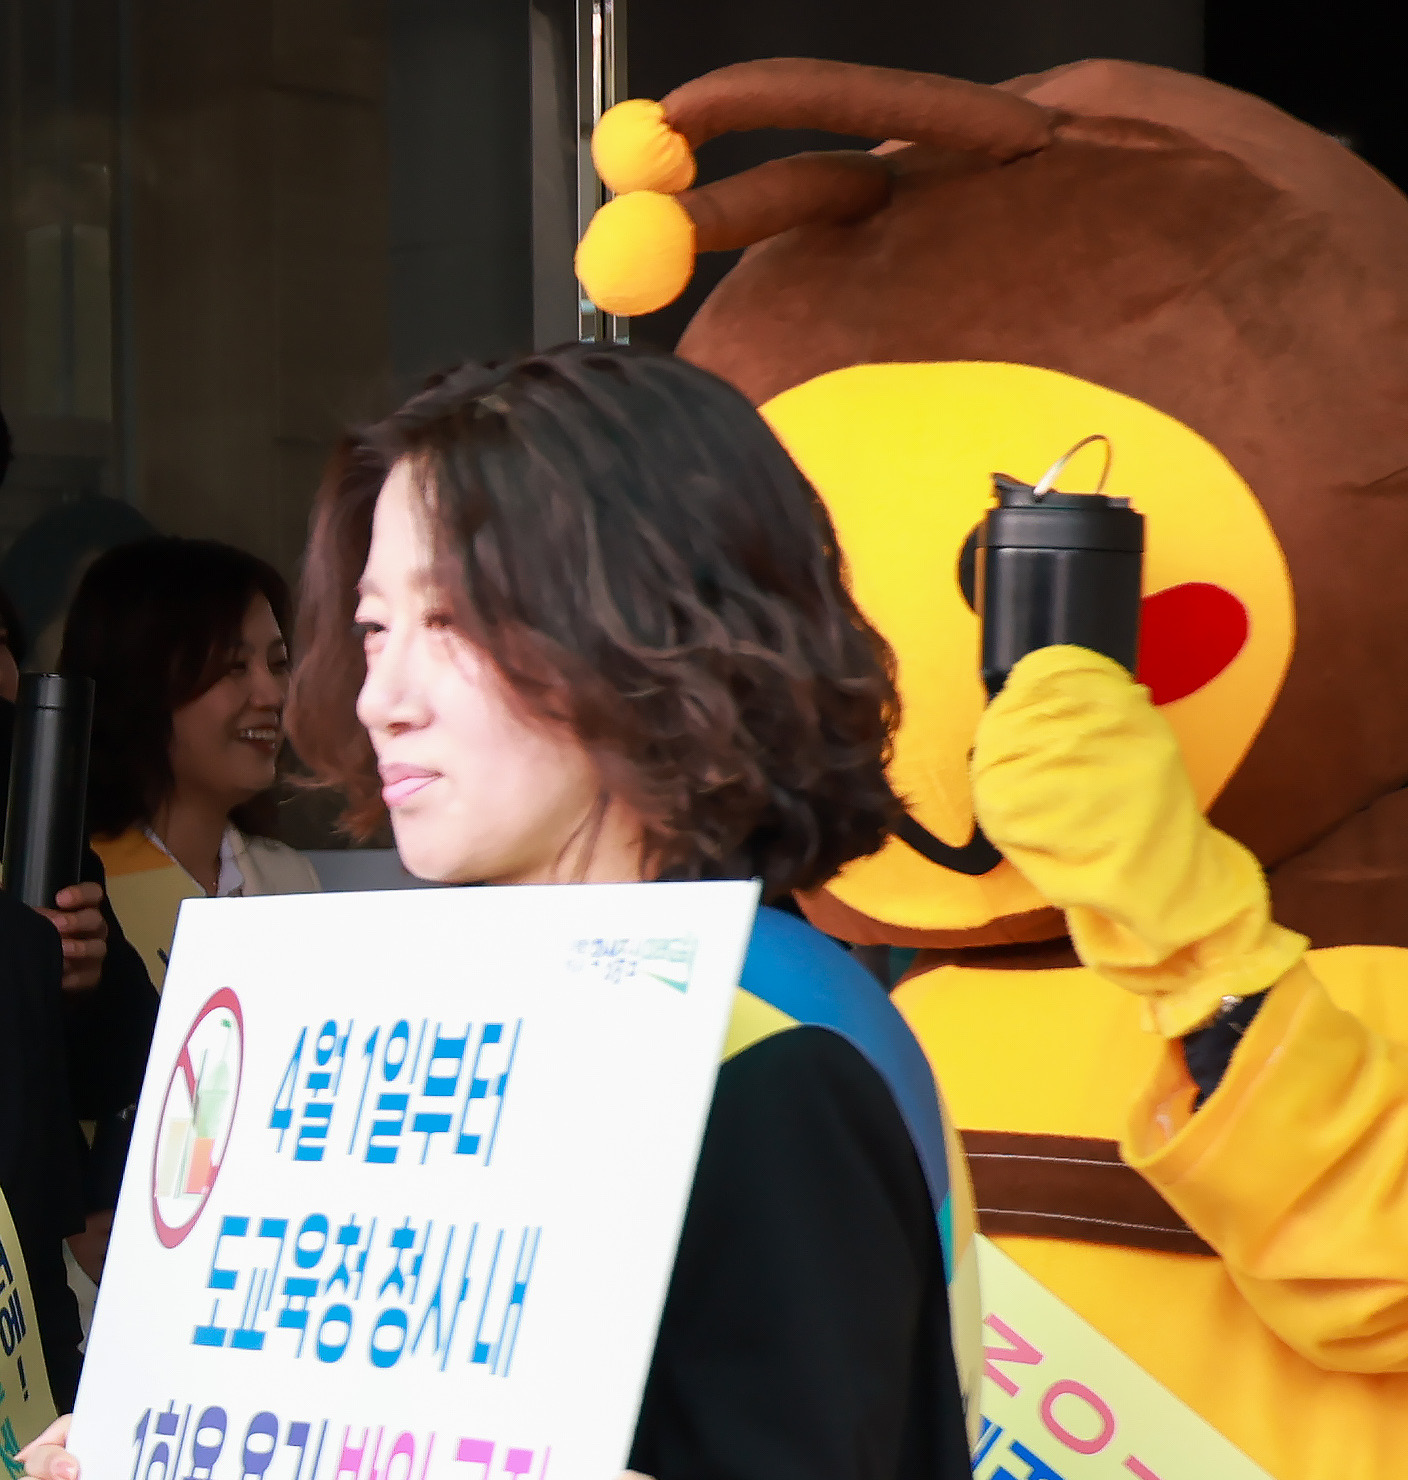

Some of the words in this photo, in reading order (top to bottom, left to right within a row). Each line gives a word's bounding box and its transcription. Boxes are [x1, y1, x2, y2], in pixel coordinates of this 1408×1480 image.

[266, 1018, 354, 1162] 4월
[346, 1018, 523, 1167] 1일부터
[190, 1212, 377, 1364] 도교육청
[368, 1216, 480, 1373] 청사
[468, 1225, 542, 1378] 내
